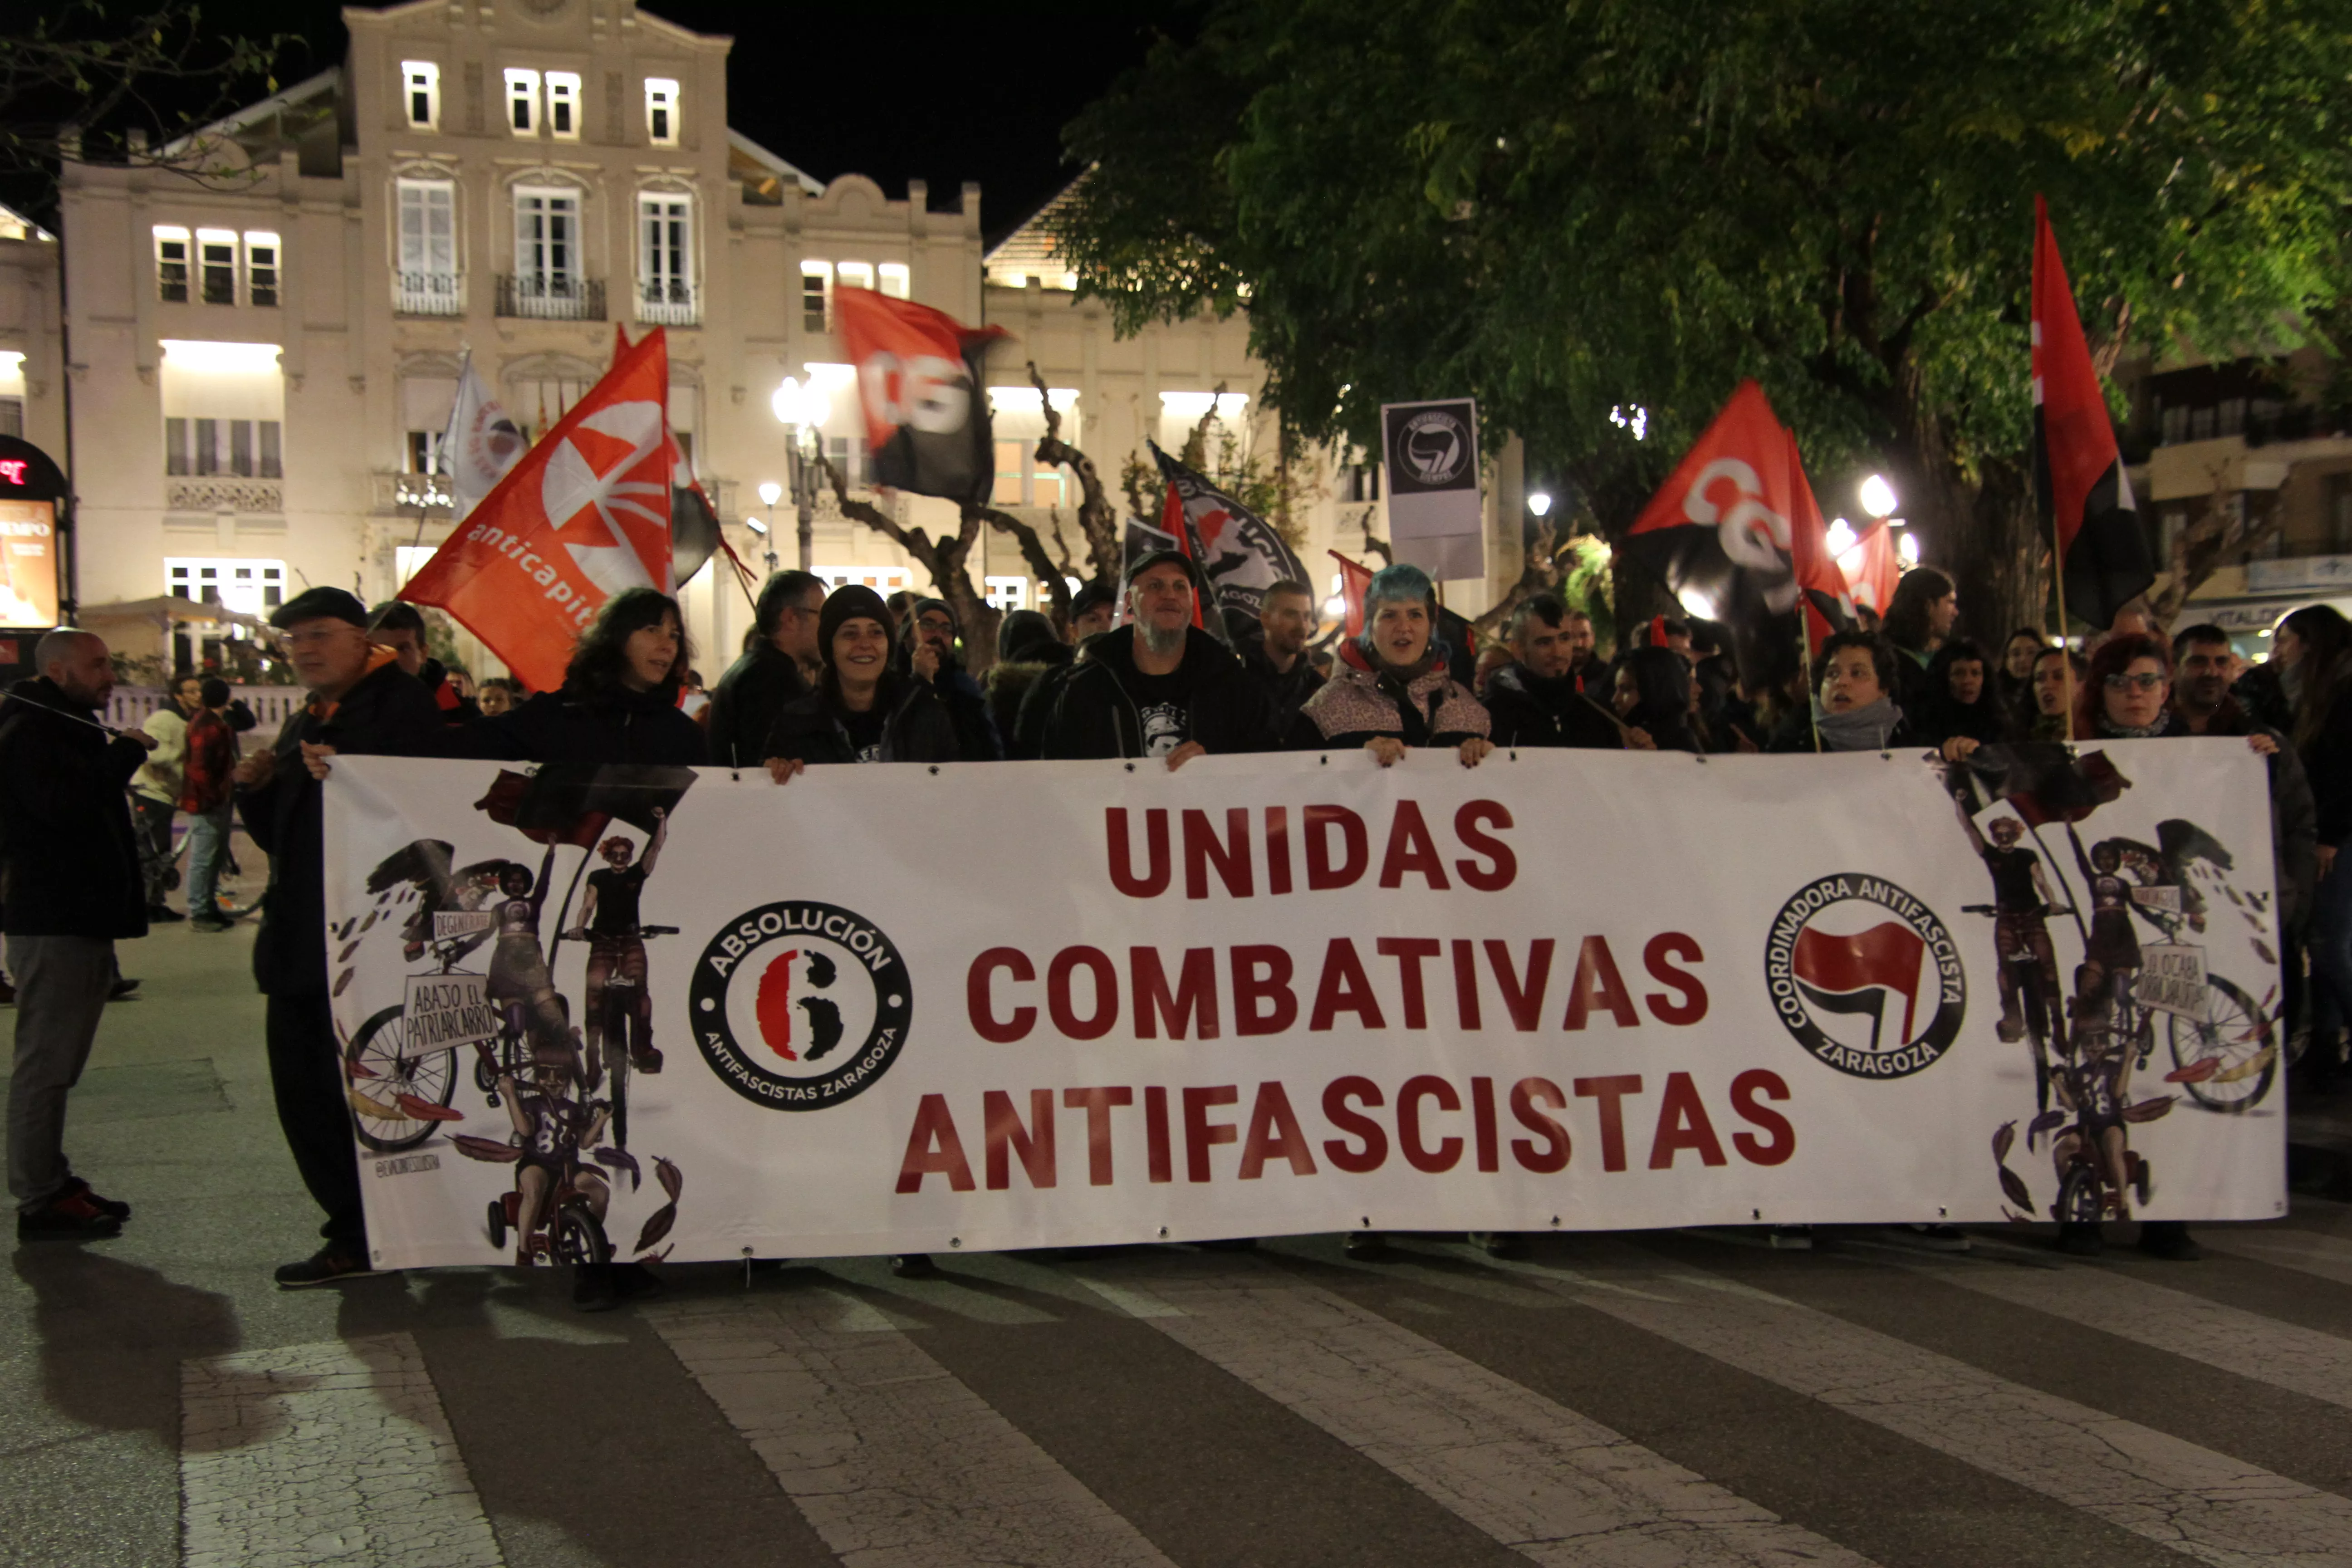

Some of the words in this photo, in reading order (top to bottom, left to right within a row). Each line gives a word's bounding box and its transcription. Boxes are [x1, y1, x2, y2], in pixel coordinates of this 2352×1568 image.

[1105, 799, 1518, 901] UNIDAS
[709, 909, 892, 978] ABSOLUCIÓN
[966, 931, 1709, 1044] COMBATIVAS
[1770, 877, 1852, 1029] COORDINADORA
[1858, 878, 1962, 1004] ANTIFASCISTA
[414, 984, 461, 1014] ABAJO
[467, 984, 481, 1005] EL
[706, 1032, 817, 1101] ANTIFASCISTAS
[821, 1027, 897, 1098] ZARAGOZA
[1816, 1037, 1939, 1074] ZARAGOZA
[895, 1068, 1797, 1195] ANTIFASCISTAS
